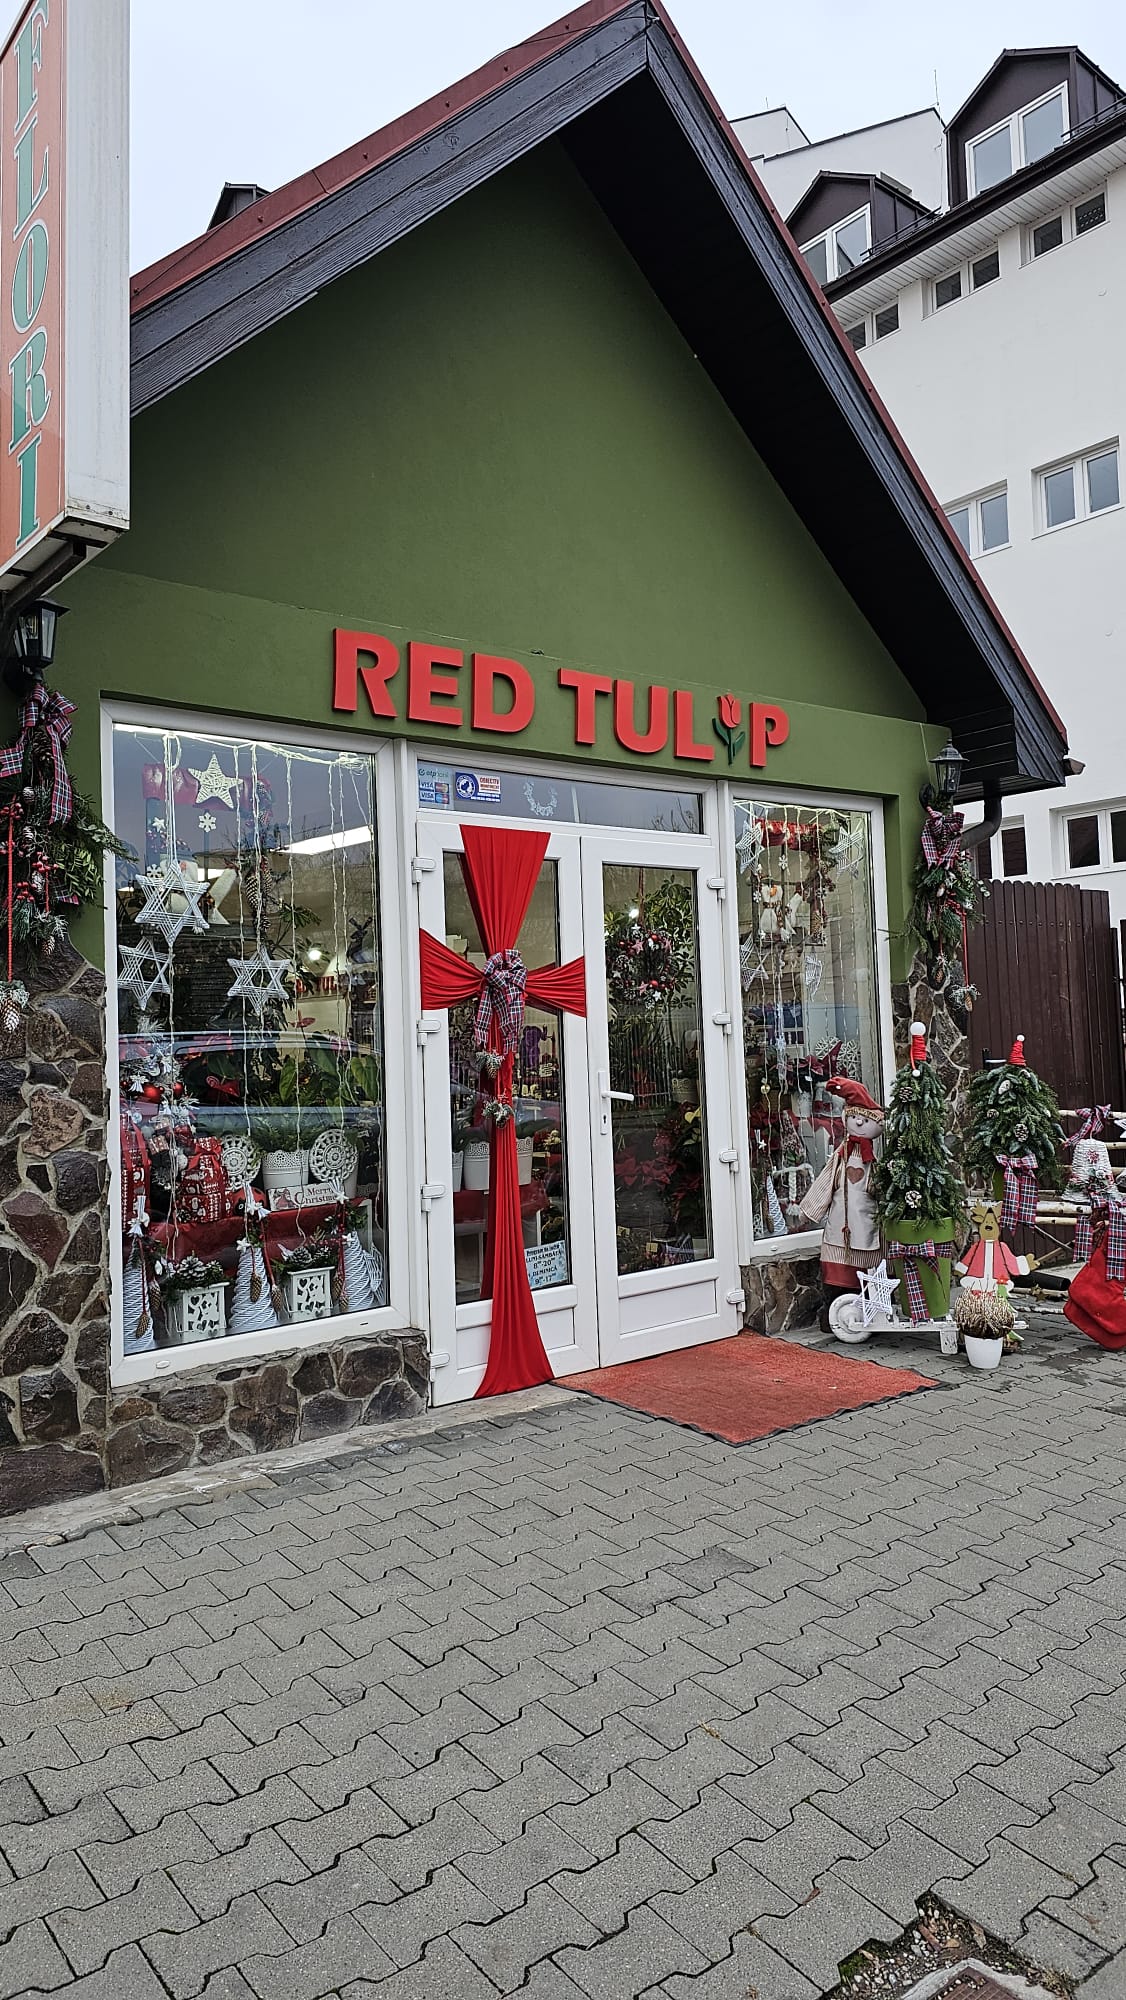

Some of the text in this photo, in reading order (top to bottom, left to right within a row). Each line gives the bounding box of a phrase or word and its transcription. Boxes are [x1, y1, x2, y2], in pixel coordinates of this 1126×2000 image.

[9, 0, 52, 549] FLORI
[333, 627, 536, 734] RED
[421, 791, 434, 799] VISA
